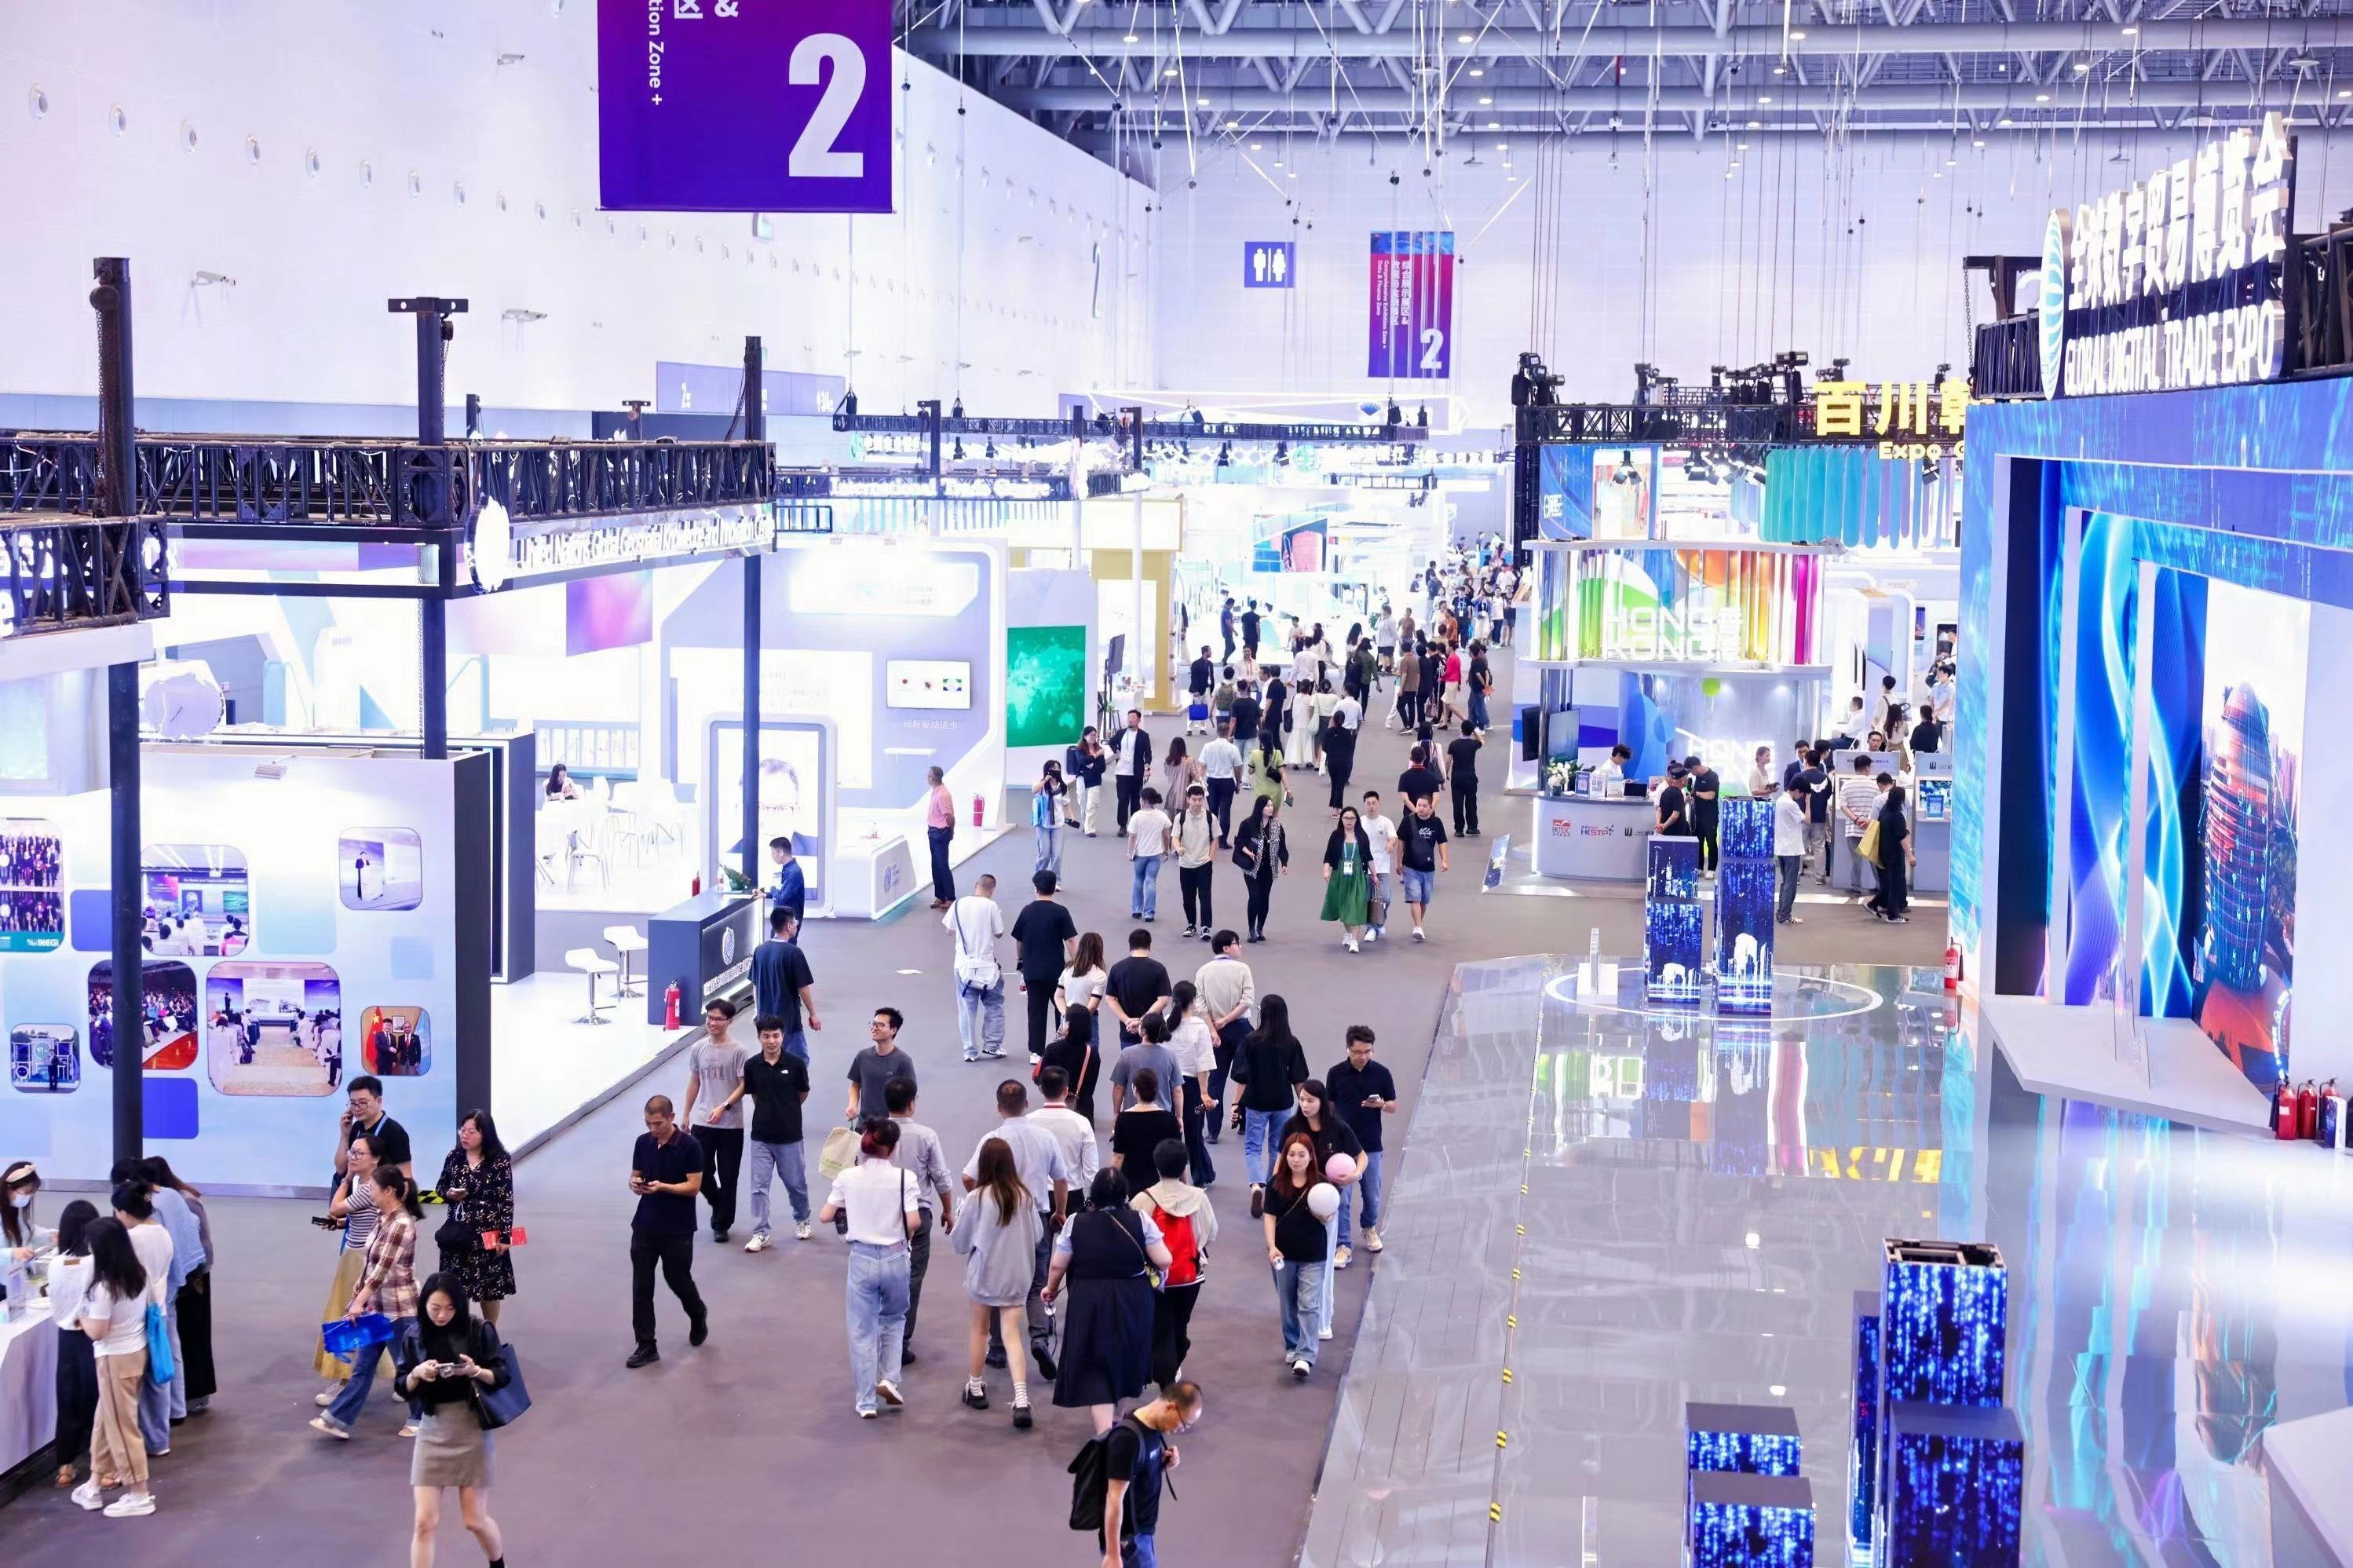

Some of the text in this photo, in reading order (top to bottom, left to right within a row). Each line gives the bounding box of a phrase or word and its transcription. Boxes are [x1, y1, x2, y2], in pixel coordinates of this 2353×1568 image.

[649, 41, 664, 89] Zone
[788, 32, 867, 177] 2
[2068, 111, 2289, 311] 全球数字贸易博览会
[1420, 328, 1444, 369] 2
[2064, 299, 2274, 397] GLOBAL DIGITAL TRADE EXPO
[1879, 440, 1942, 464] Expo
[1604, 605, 1713, 634] HONG
[1603, 634, 1716, 661] KONG
